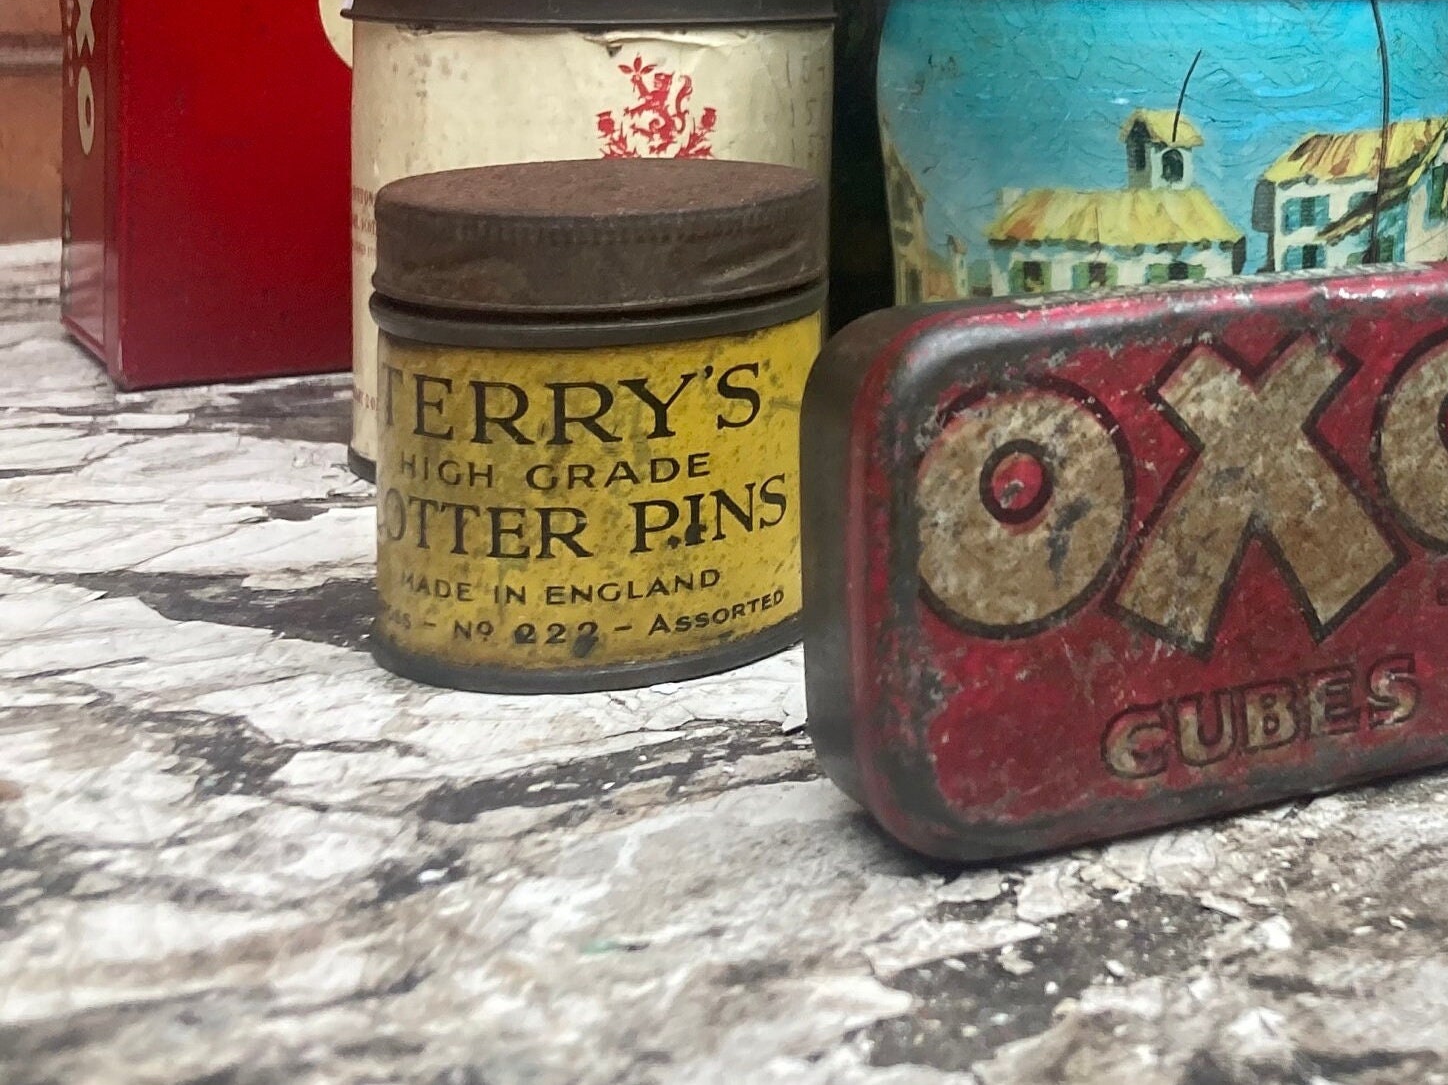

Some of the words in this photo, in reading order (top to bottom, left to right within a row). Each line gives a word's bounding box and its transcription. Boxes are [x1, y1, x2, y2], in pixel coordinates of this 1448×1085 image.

[377, 362, 761, 445] TERRY'S
[401, 451, 494, 488] HIGH
[525, 452, 711, 491] GRADE
[378, 487, 594, 559] OTTER
[629, 473, 787, 554] PINS
[402, 570, 474, 602] MADE
[494, 585, 526, 606] IN
[546, 568, 721, 606] ENGLAND
[1101, 654, 1422, 780] CUBES
